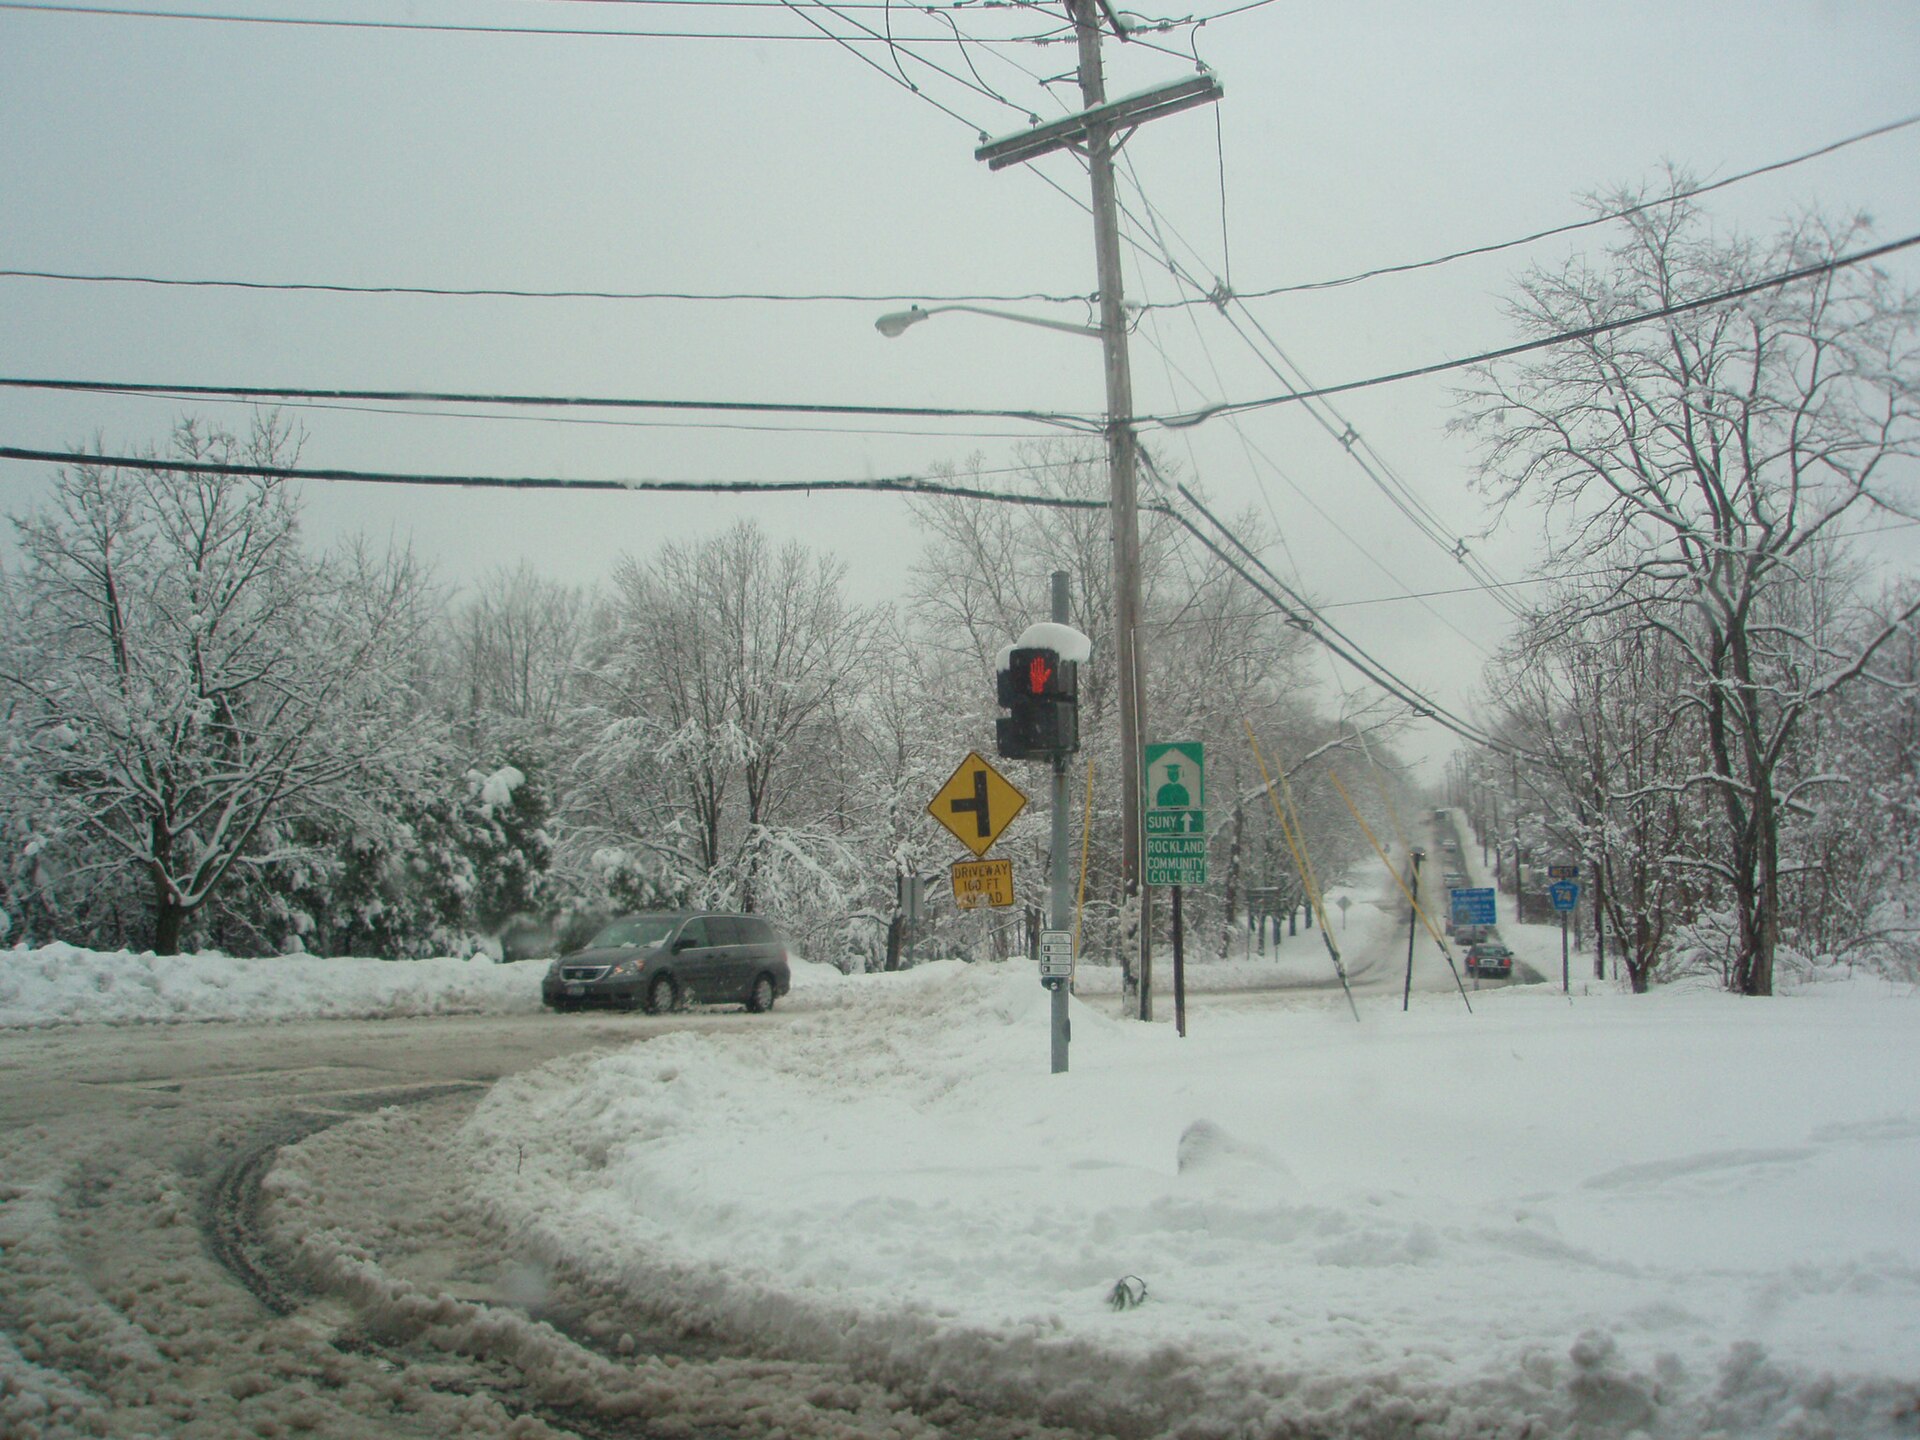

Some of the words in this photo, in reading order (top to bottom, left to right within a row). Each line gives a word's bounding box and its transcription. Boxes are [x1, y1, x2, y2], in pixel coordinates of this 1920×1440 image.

[1148, 816, 1177, 829] SUNY
[1148, 840, 1204, 853] ROCKLAND
[1147, 857, 1204, 870] COMMUNITY
[954, 863, 1008, 879] DRIVEWAY
[1151, 871, 1203, 883] COLLEGE
[964, 879, 982, 891] 100
[986, 878, 999, 890] FT
[1555, 888, 1571, 901] 74
